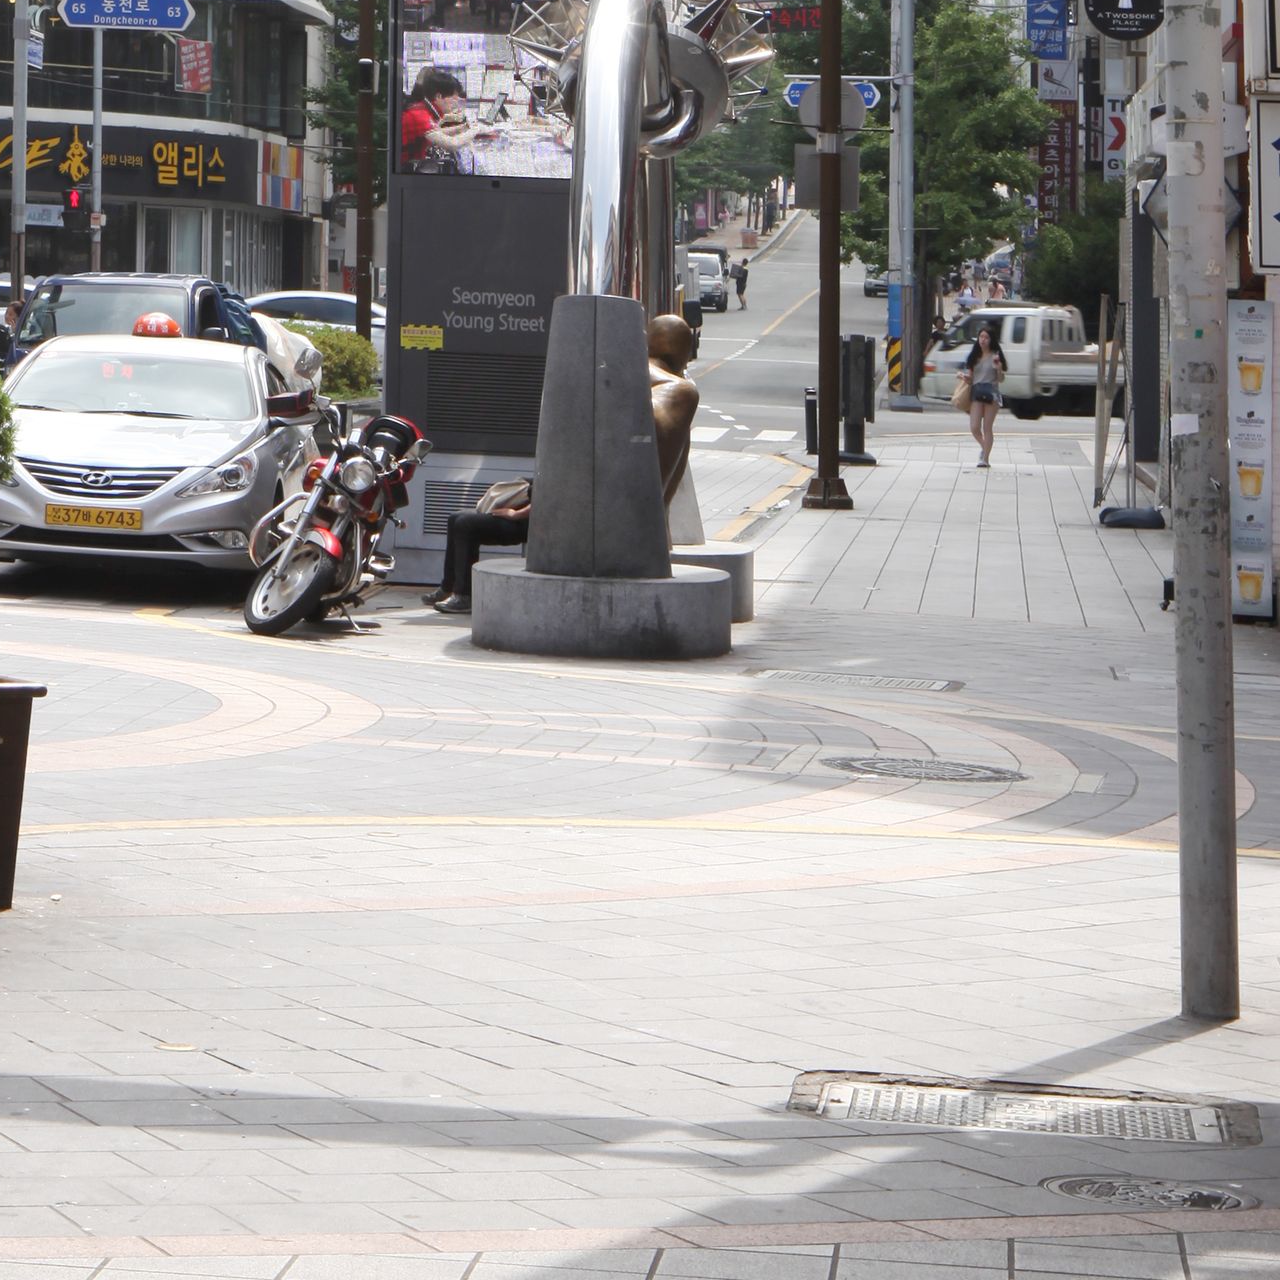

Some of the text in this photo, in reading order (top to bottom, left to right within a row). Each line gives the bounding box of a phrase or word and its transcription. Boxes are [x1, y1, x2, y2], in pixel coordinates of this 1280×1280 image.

[72, 3, 181, 17] 65 63
[771, 6, 821, 30] 속시간
[1105, 11, 1156, 20] TWOSOME
[93, 15, 158, 26] Dongcheon-ro
[120, 153, 144, 168] 나라의
[152, 142, 226, 188] 앨리스
[452, 287, 536, 308] Seomyeon
[443, 311, 545, 333] Young Street
[95, 508, 136, 527] 6743
